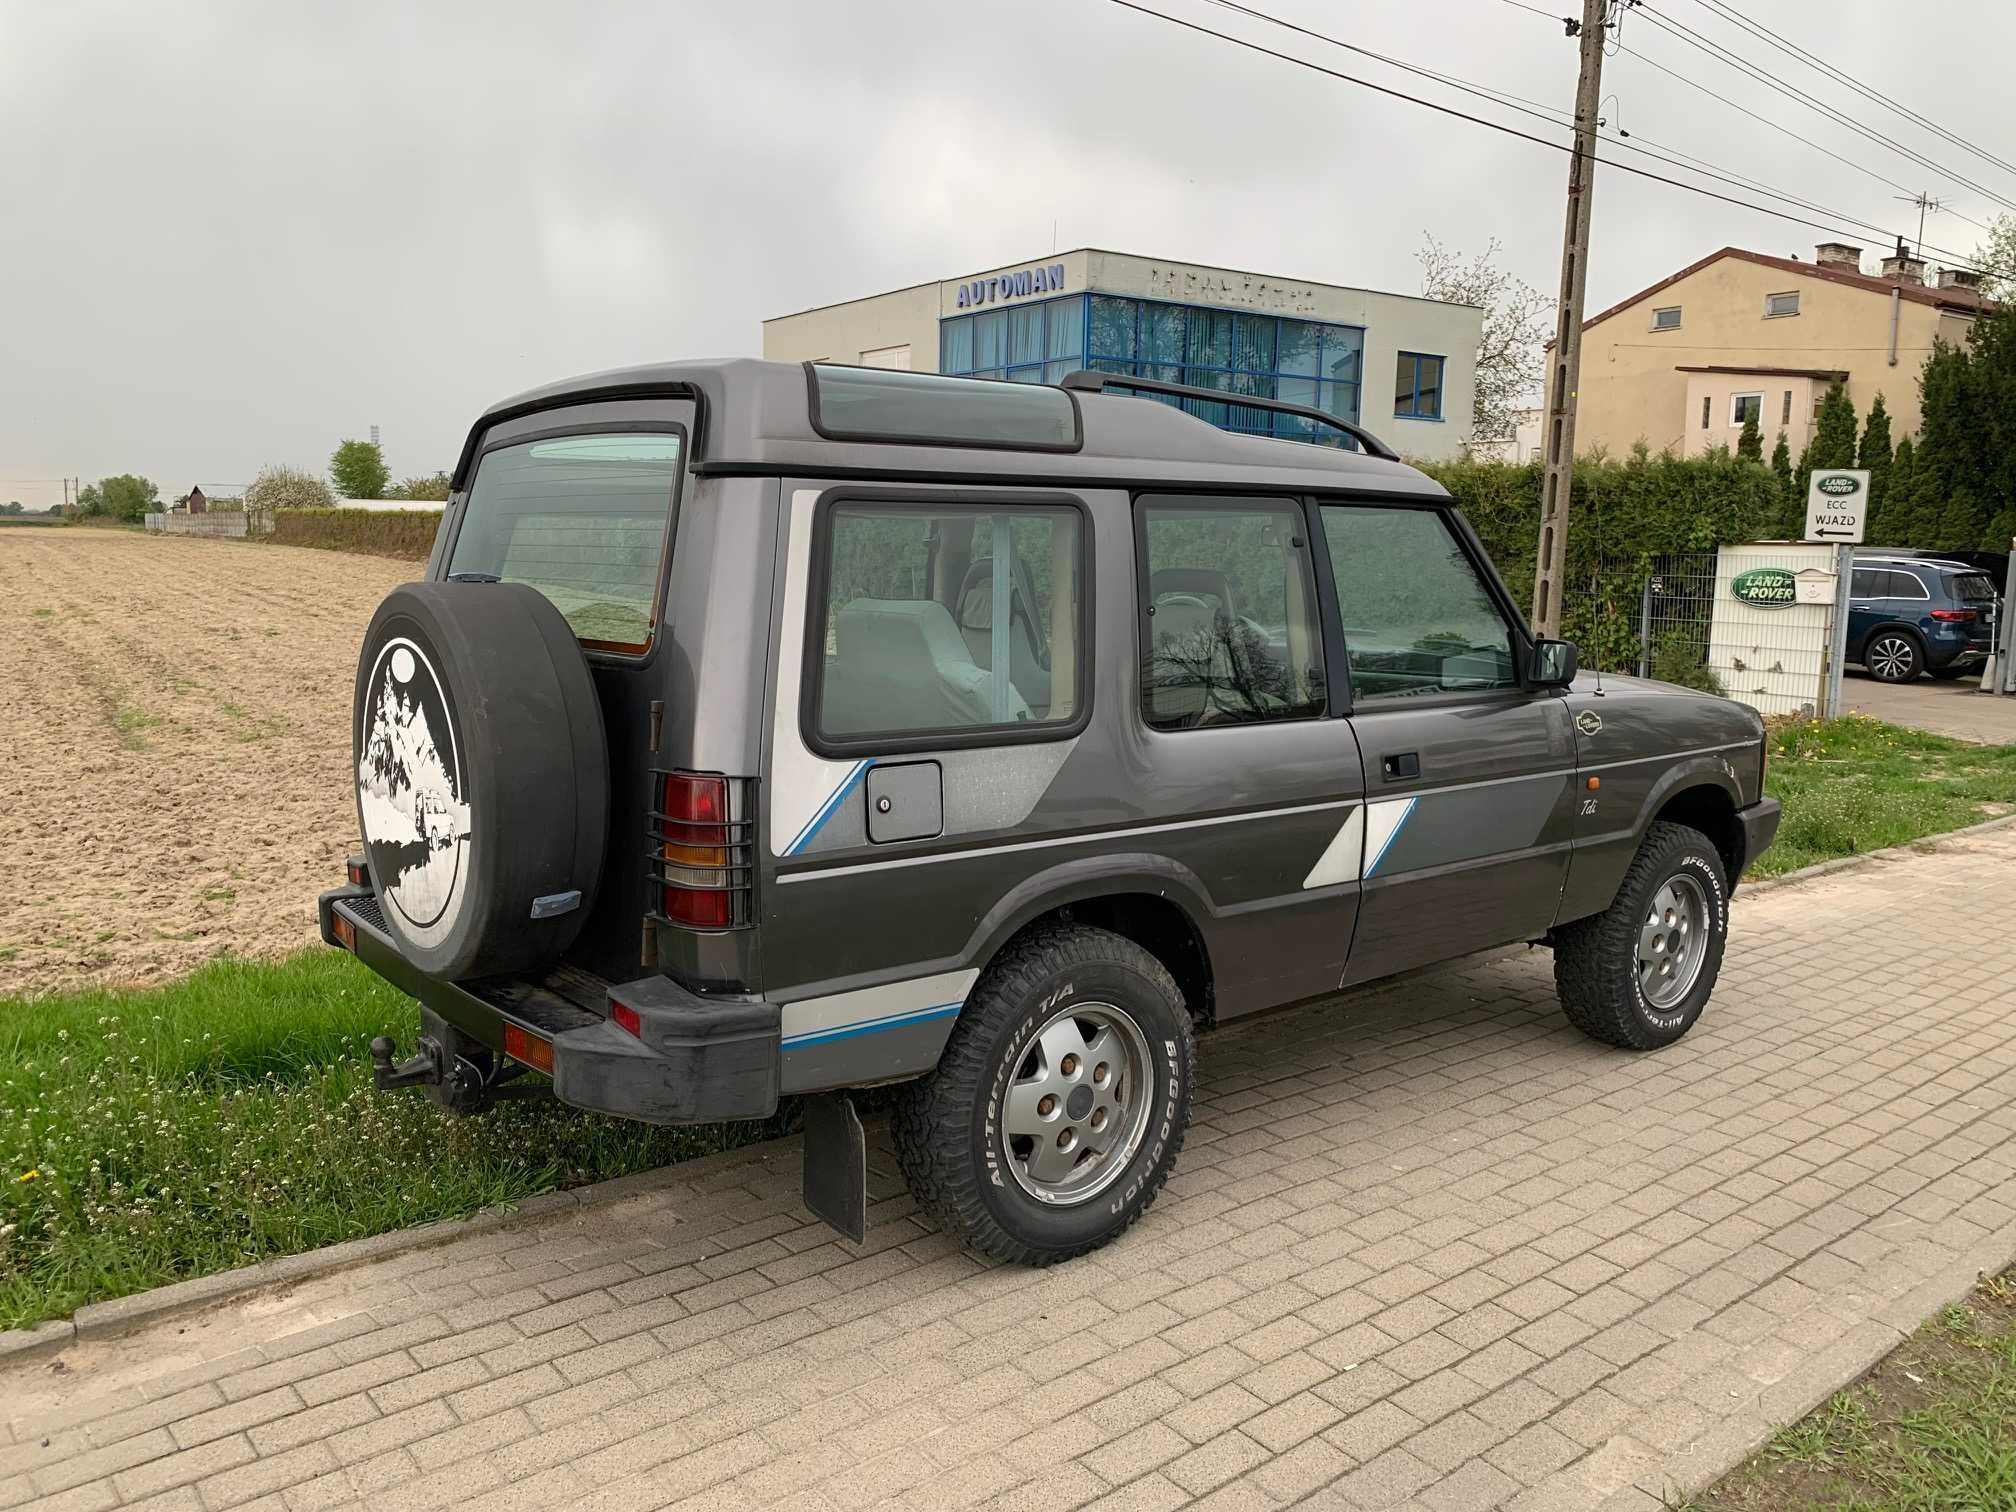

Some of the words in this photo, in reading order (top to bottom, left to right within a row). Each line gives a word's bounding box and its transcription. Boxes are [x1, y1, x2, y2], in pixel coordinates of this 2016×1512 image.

[957, 263, 1065, 308] AUTOMAN
[1825, 478, 1847, 487] LAND
[1826, 485, 1854, 493] ROVER
[1826, 500, 1848, 510] ECC
[1815, 515, 1856, 526] WJAZD
[1746, 575, 1783, 587] LAND
[1747, 588, 1794, 600] ROVER
[1580, 798, 1598, 816] Tdi
[984, 1017, 1034, 1188] All-Terrain
[1038, 982, 1075, 1014] T/A
[1111, 1040, 1179, 1214] BFGoodrich
